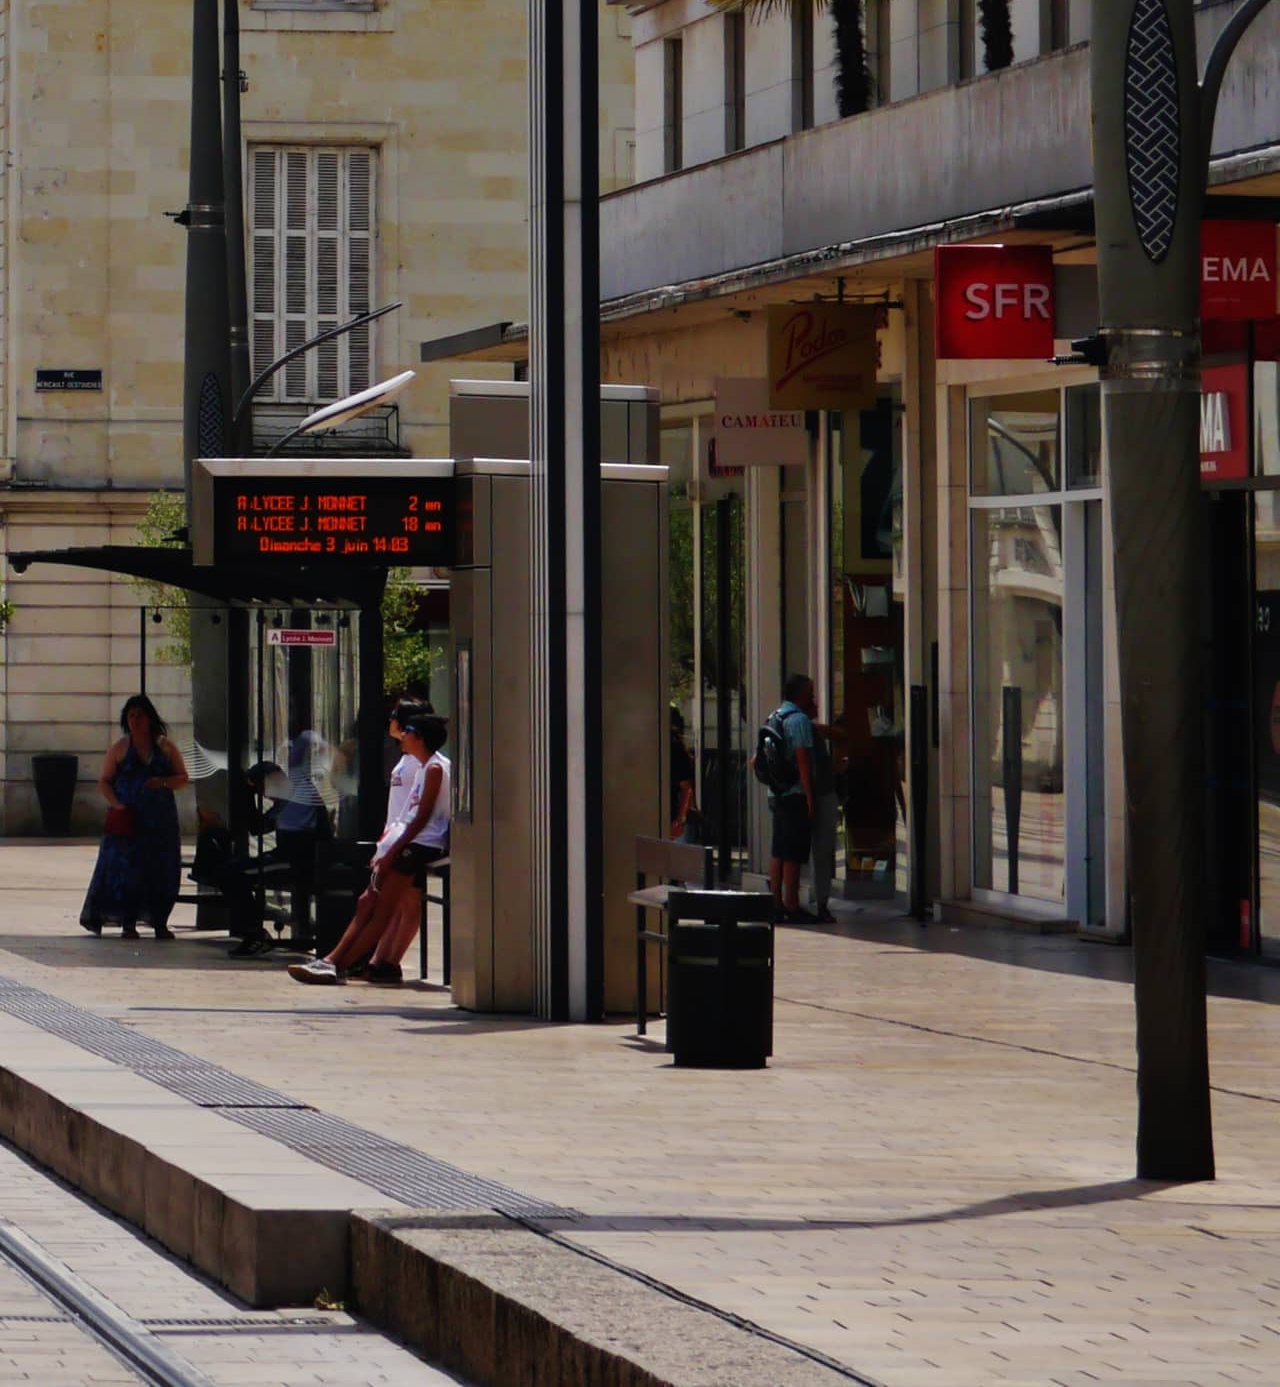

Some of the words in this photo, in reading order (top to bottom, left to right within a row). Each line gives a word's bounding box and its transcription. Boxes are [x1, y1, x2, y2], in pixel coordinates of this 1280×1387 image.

[965, 282, 1051, 320] SFR
[237, 495, 247, 511] A
[318, 495, 367, 511] MONNET
[408, 495, 419, 511] 2
[237, 515, 247, 531] A
[318, 515, 367, 531] MONNET
[401, 516, 419, 532] 18
[259, 537, 322, 553] Dimanche
[326, 537, 336, 552] 3
[342, 538, 369, 554] juin
[372, 537, 409, 553] 14:03
[271, 633, 279, 641] A
